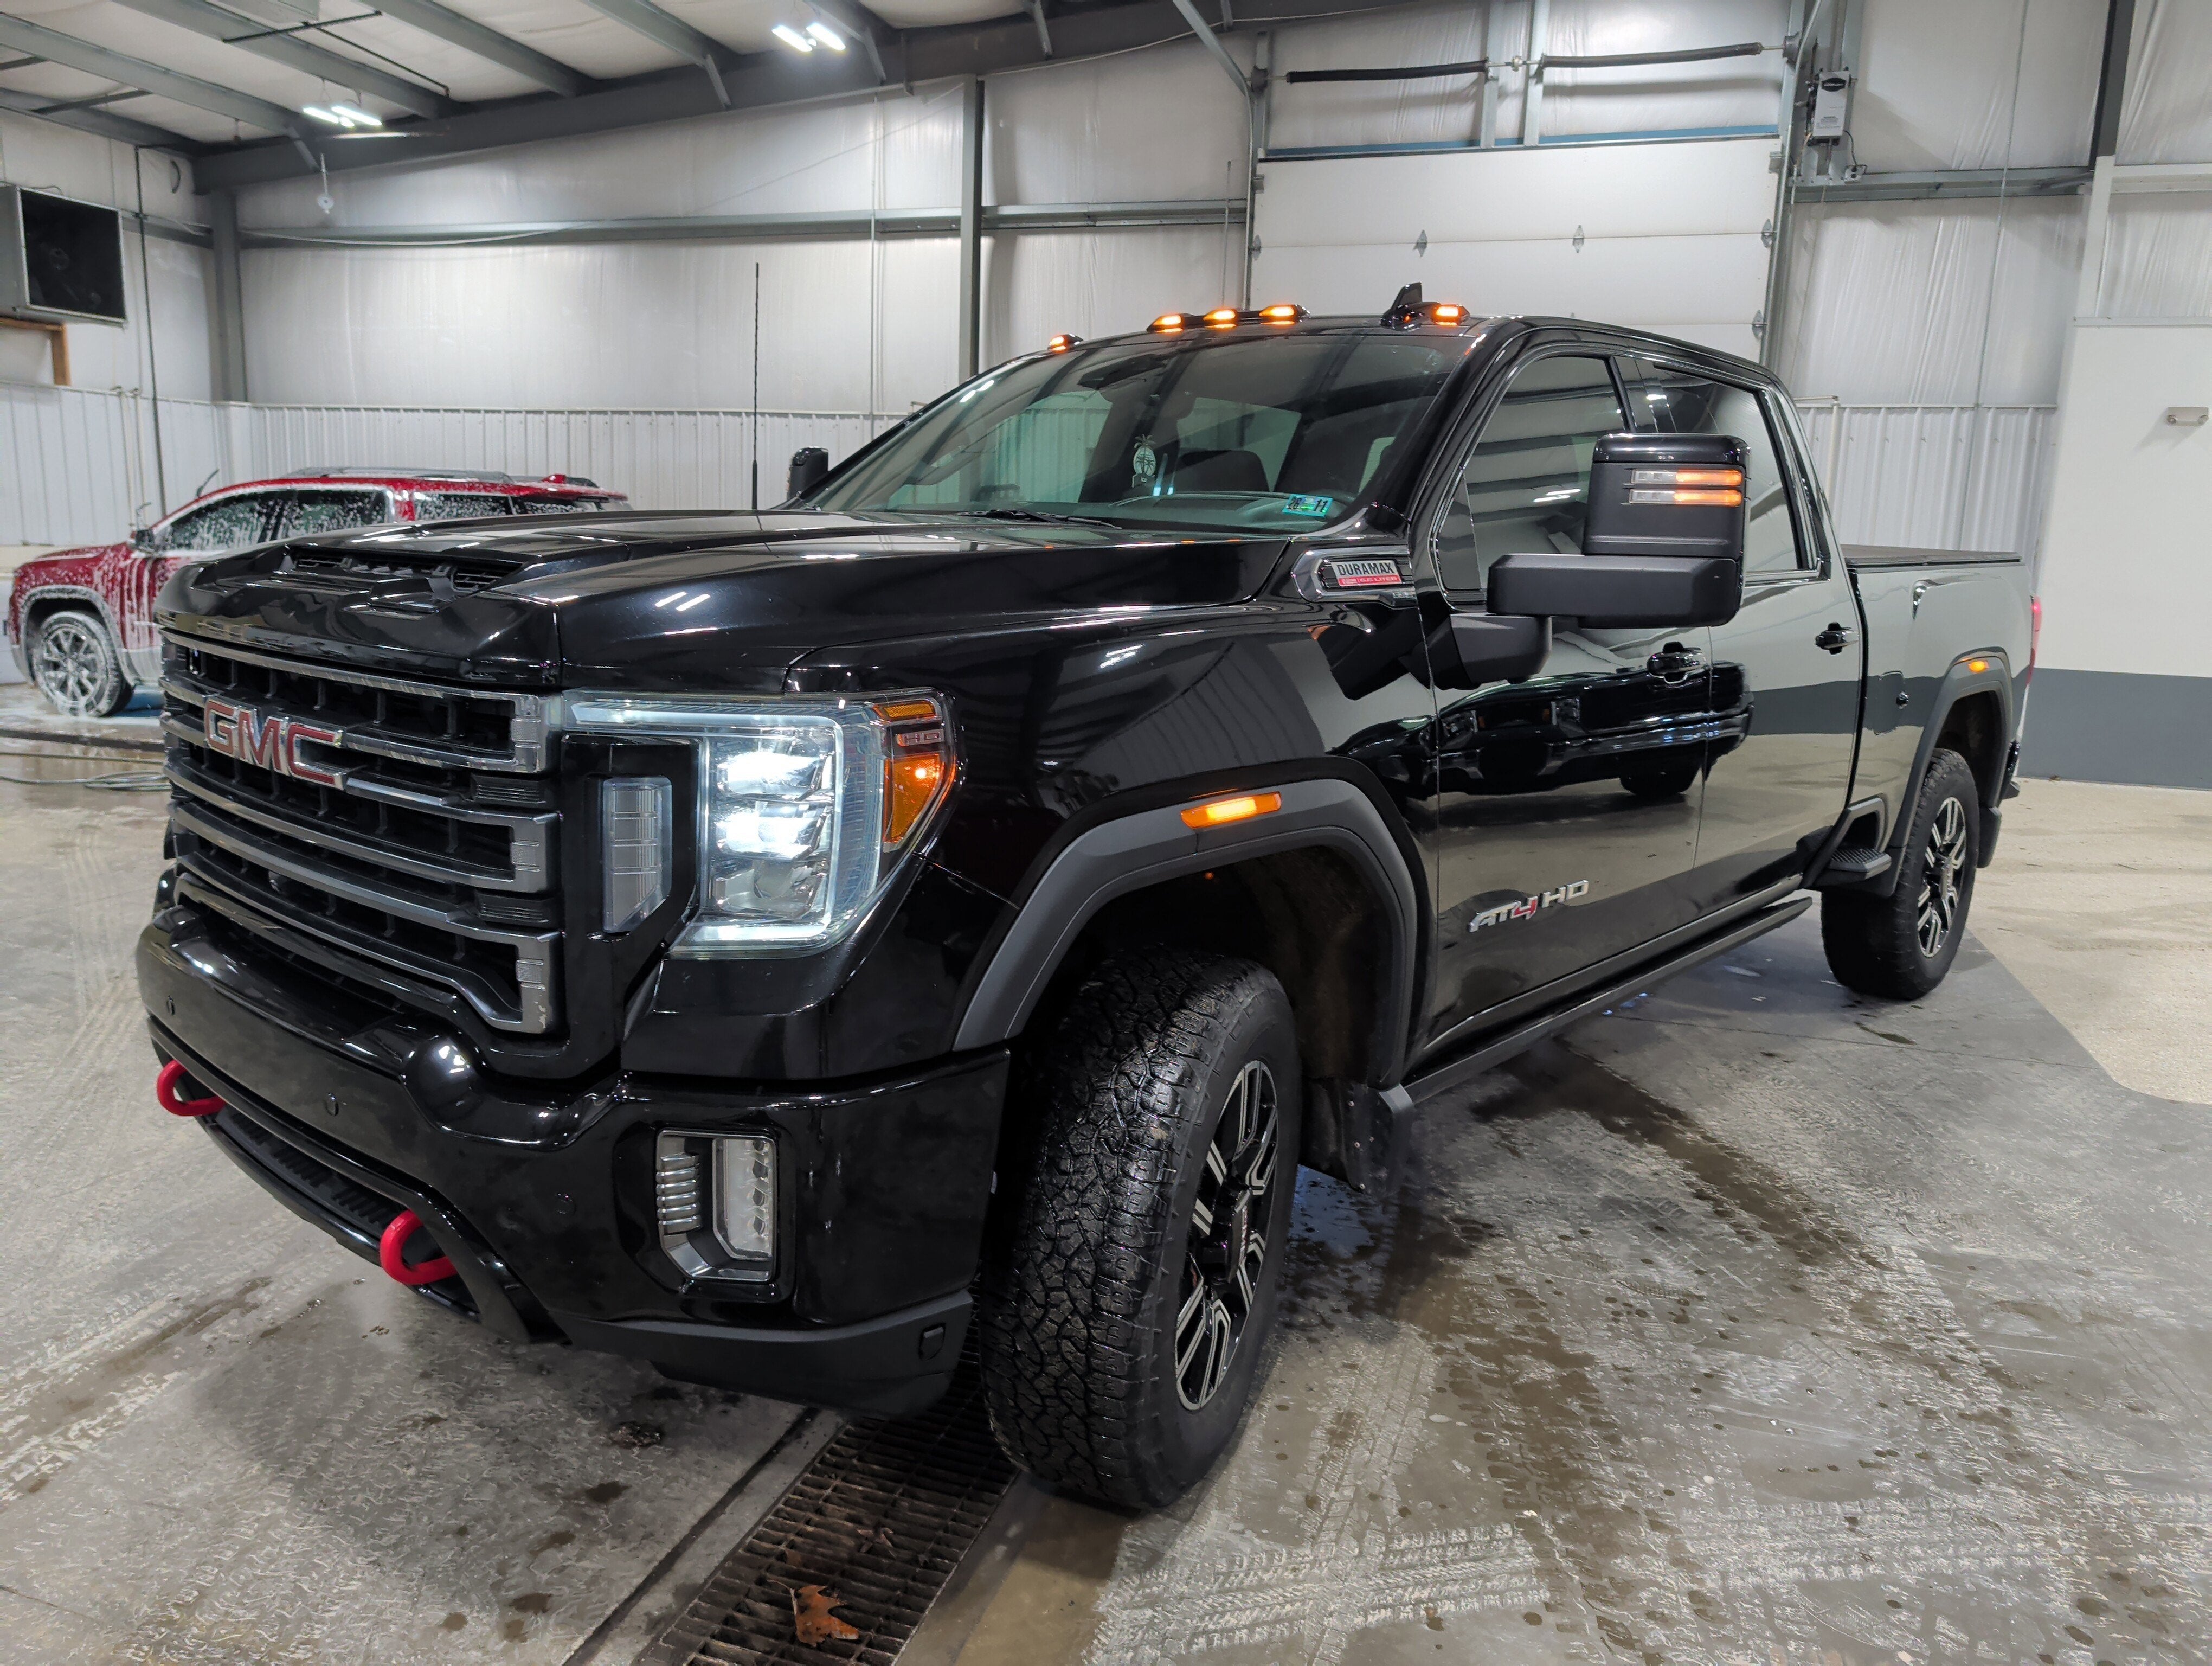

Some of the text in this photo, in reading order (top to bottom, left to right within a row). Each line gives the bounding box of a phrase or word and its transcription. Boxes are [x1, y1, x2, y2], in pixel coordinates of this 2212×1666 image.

[1313, 499, 1328, 512] 11
[1336, 562, 1395, 576] DURAMAX
[901, 731, 941, 744] HD
[203, 699, 344, 791] GMC
[1468, 879, 1589, 933] AT4 HD
